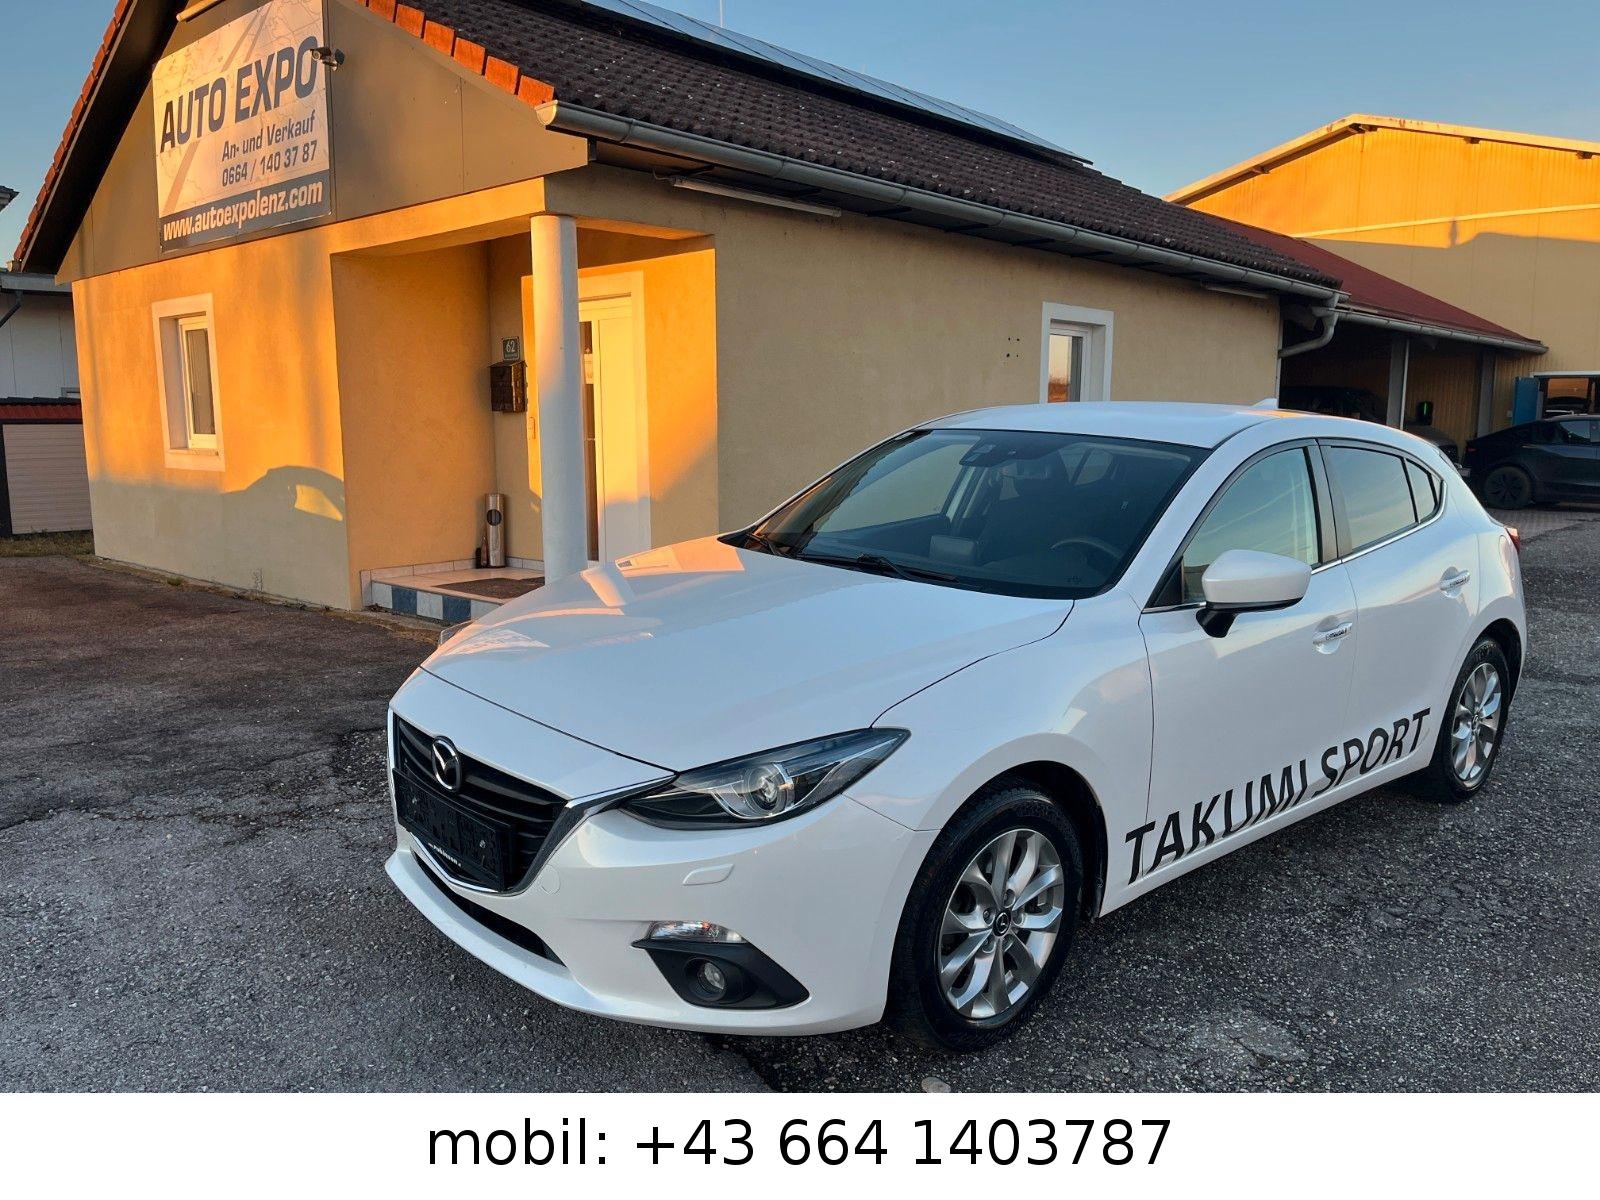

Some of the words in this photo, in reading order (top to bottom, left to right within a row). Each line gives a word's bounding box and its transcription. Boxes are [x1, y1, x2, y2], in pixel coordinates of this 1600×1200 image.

[160, 77, 227, 153] AUTO
[235, 36, 318, 124] EXPO
[222, 140, 239, 162] An-
[243, 128, 263, 154] und
[267, 109, 315, 146] Verkauf
[222, 162, 248, 187] 0664
[250, 158, 257, 182] /
[260, 151, 281, 175] 140
[284, 146, 298, 168] 37
[302, 140, 317, 162] 87
[163, 180, 322, 241] www.autoexpolenz.com
[506, 340, 516, 352] 62
[1125, 759, 1308, 886] TAKUMI
[1311, 707, 1430, 798] SPORT
